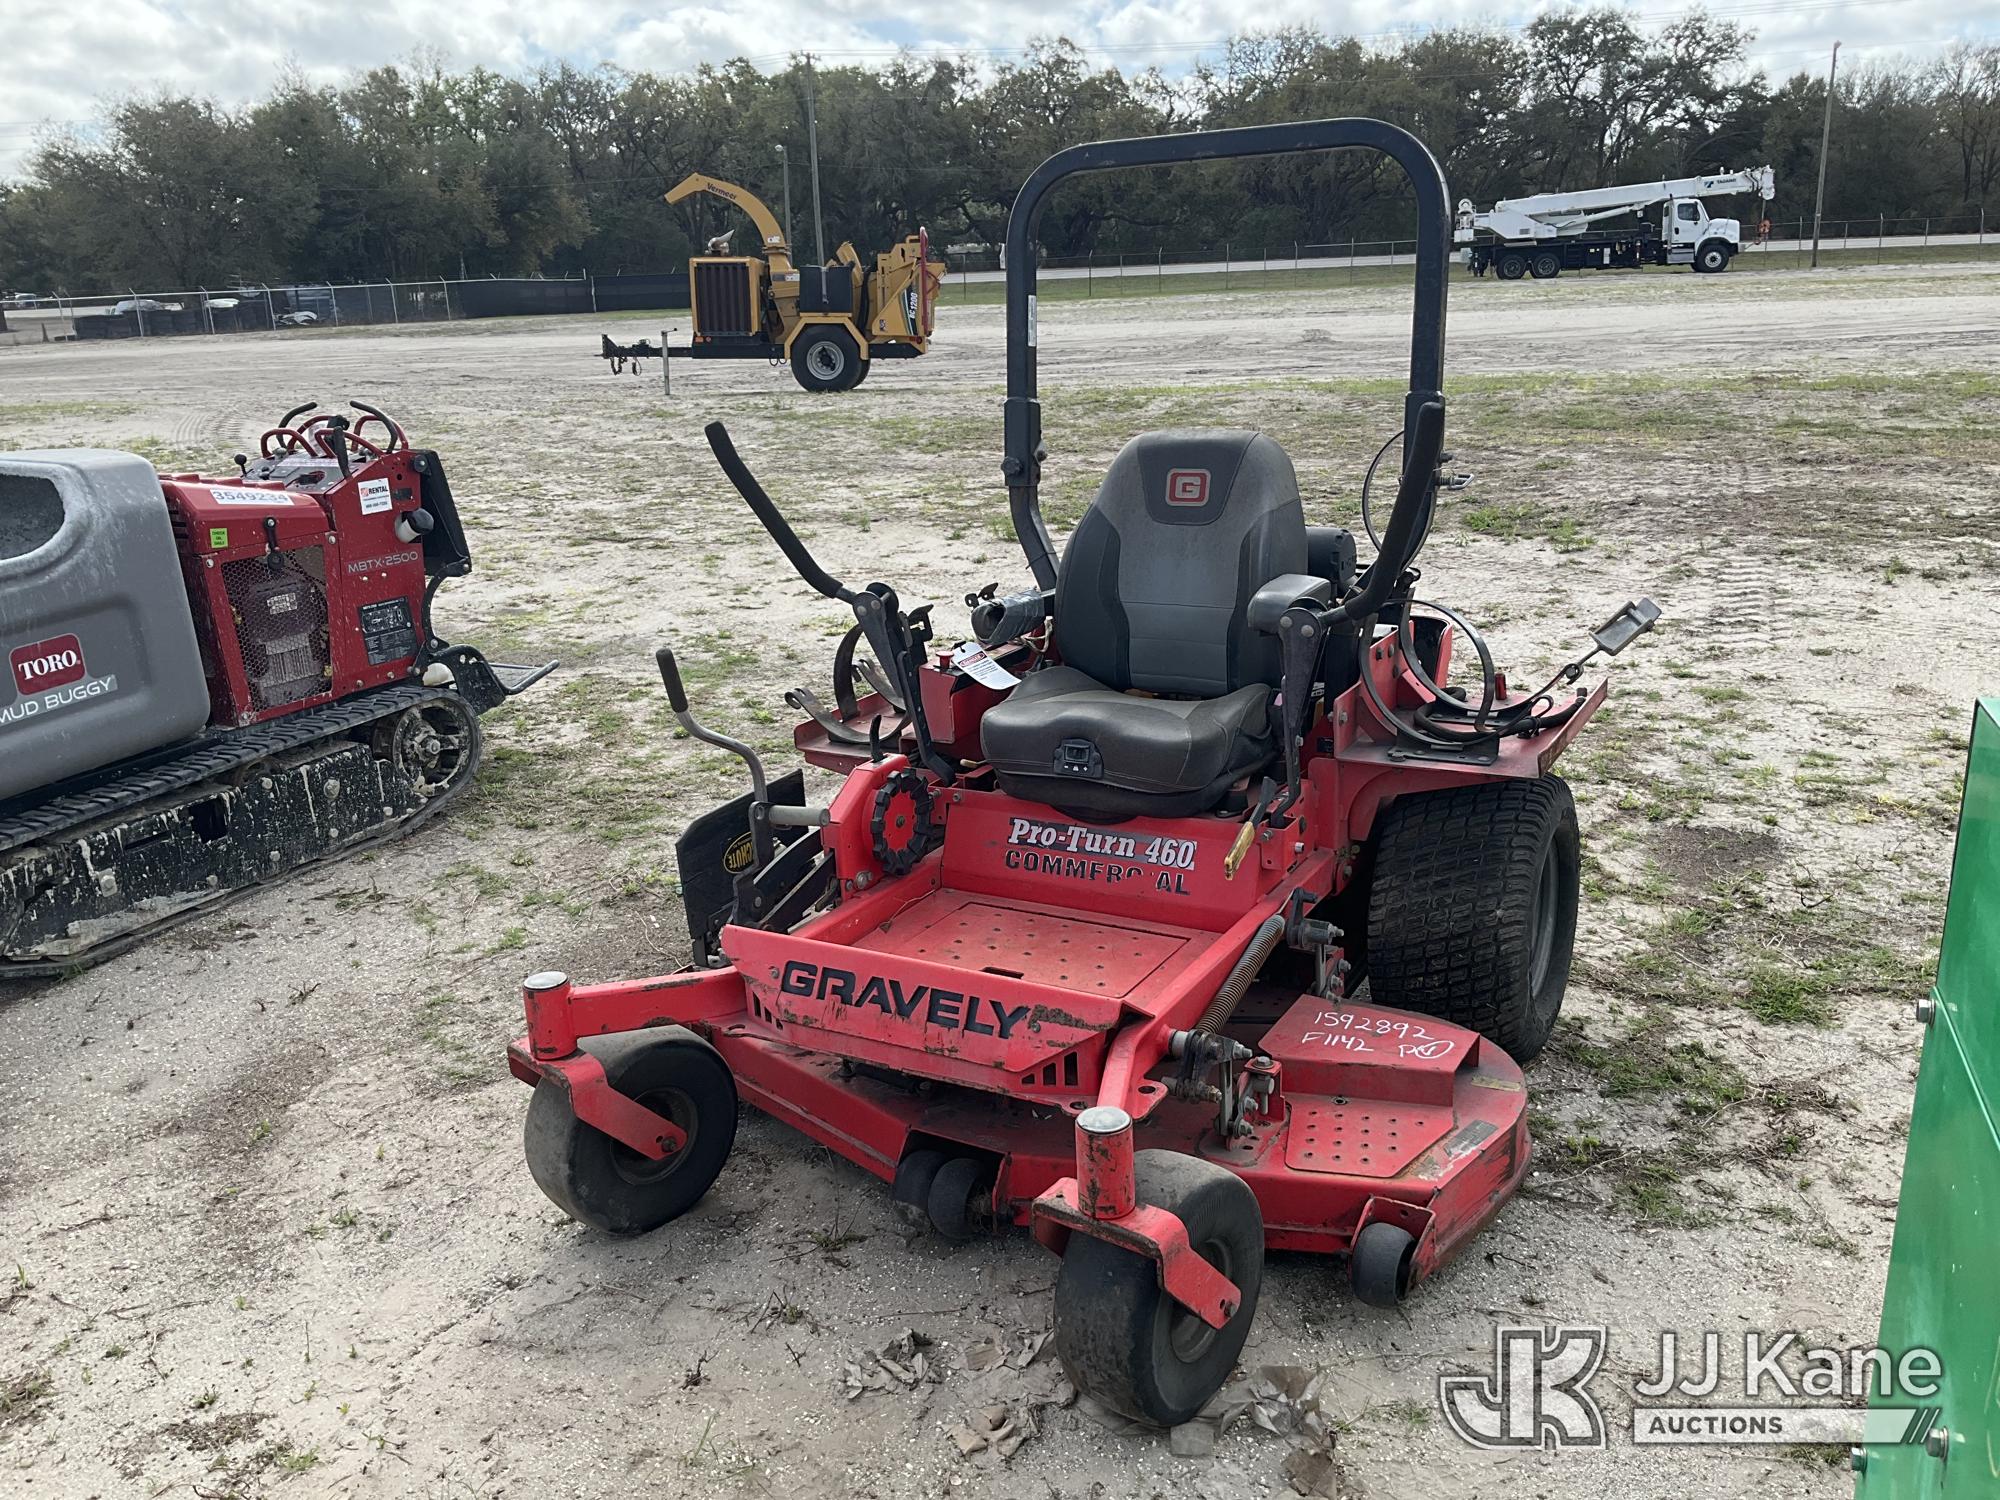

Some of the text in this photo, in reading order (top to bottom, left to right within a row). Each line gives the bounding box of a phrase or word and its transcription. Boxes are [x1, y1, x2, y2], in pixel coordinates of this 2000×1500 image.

[707, 182, 737, 200] Vermeer
[910, 292, 918, 310] 1200
[212, 490, 289, 502] 3549234
[368, 485, 389, 495] RENTAL
[18, 650, 77, 680] TORO
[44, 677, 112, 710] BUGGY
[1008, 818, 1197, 869] Pro-Turn 460
[781, 960, 1031, 1039] GRAVELY
[1314, 1011, 1435, 1040] 1592892
[1301, 1032, 1375, 1051] F1142
